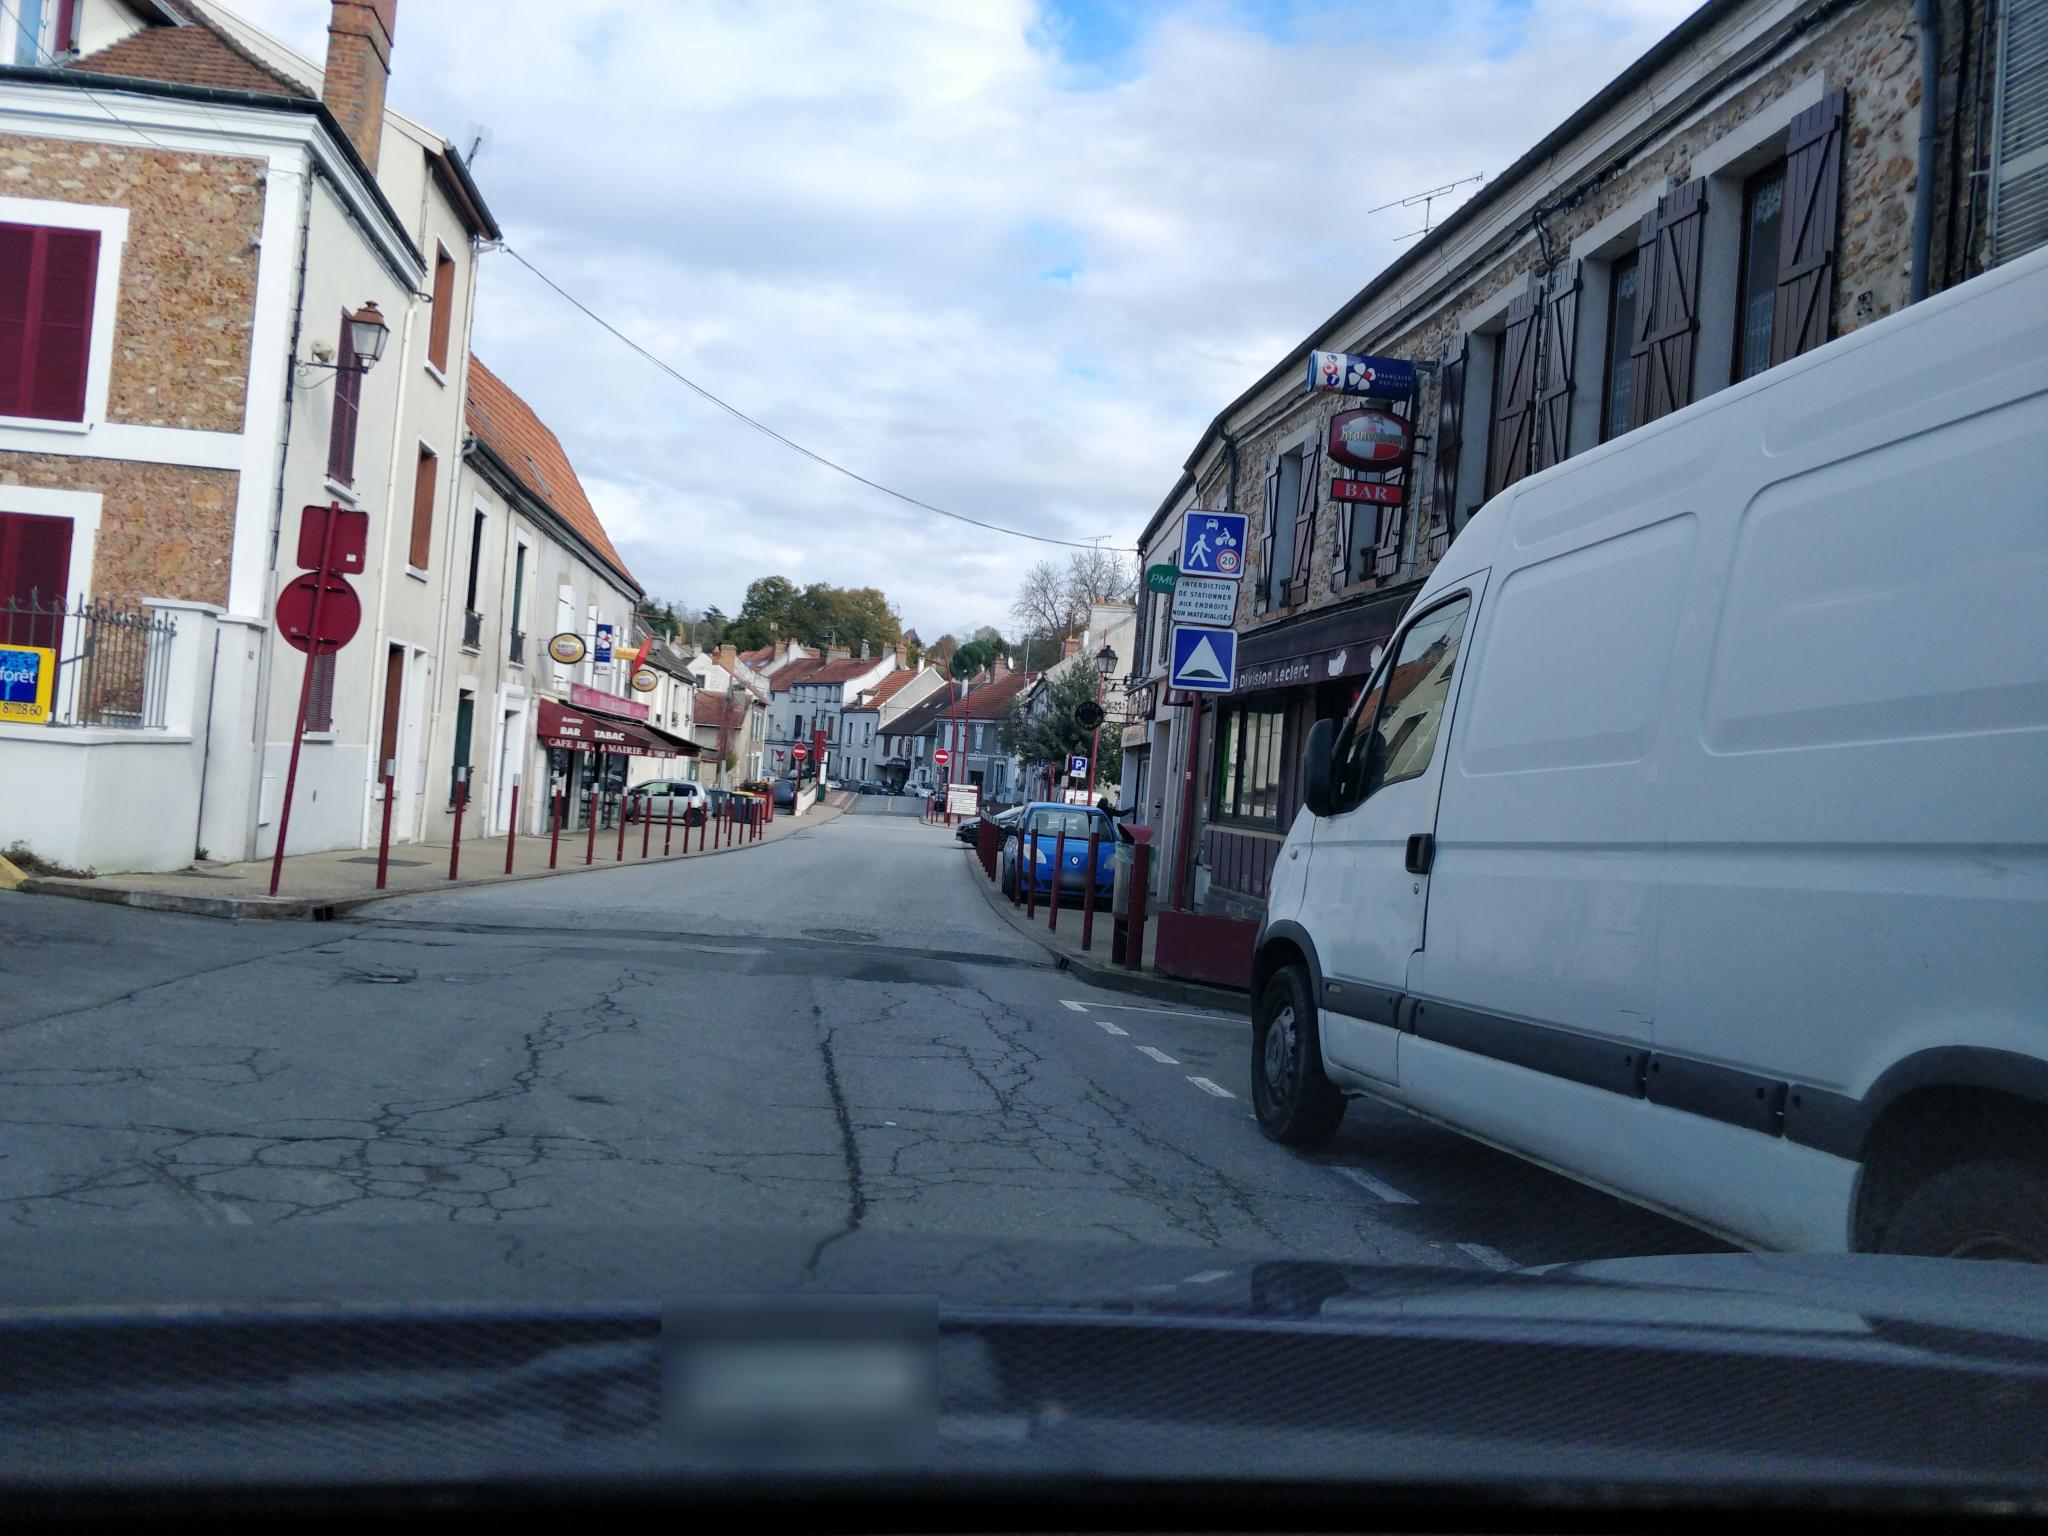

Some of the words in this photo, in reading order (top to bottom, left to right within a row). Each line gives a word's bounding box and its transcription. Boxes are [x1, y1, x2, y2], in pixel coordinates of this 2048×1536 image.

[1345, 483, 1388, 500] BAR
[1221, 556, 1235, 566] 20
[1150, 573, 1175, 586] PMU
[1182, 581, 1231, 590] INTERDICTION
[1190, 591, 1232, 600] STATIONNER
[1195, 602, 1229, 611] ENDROITS
[1239, 670, 1273, 688] Division
[1275, 664, 1310, 683] Leclerc
[560, 726, 581, 737] BAR
[593, 729, 626, 741] TABAC
[548, 737, 573, 748] CAFE
[576, 740, 589, 750] DE
[608, 744, 643, 755] MAIRIE
